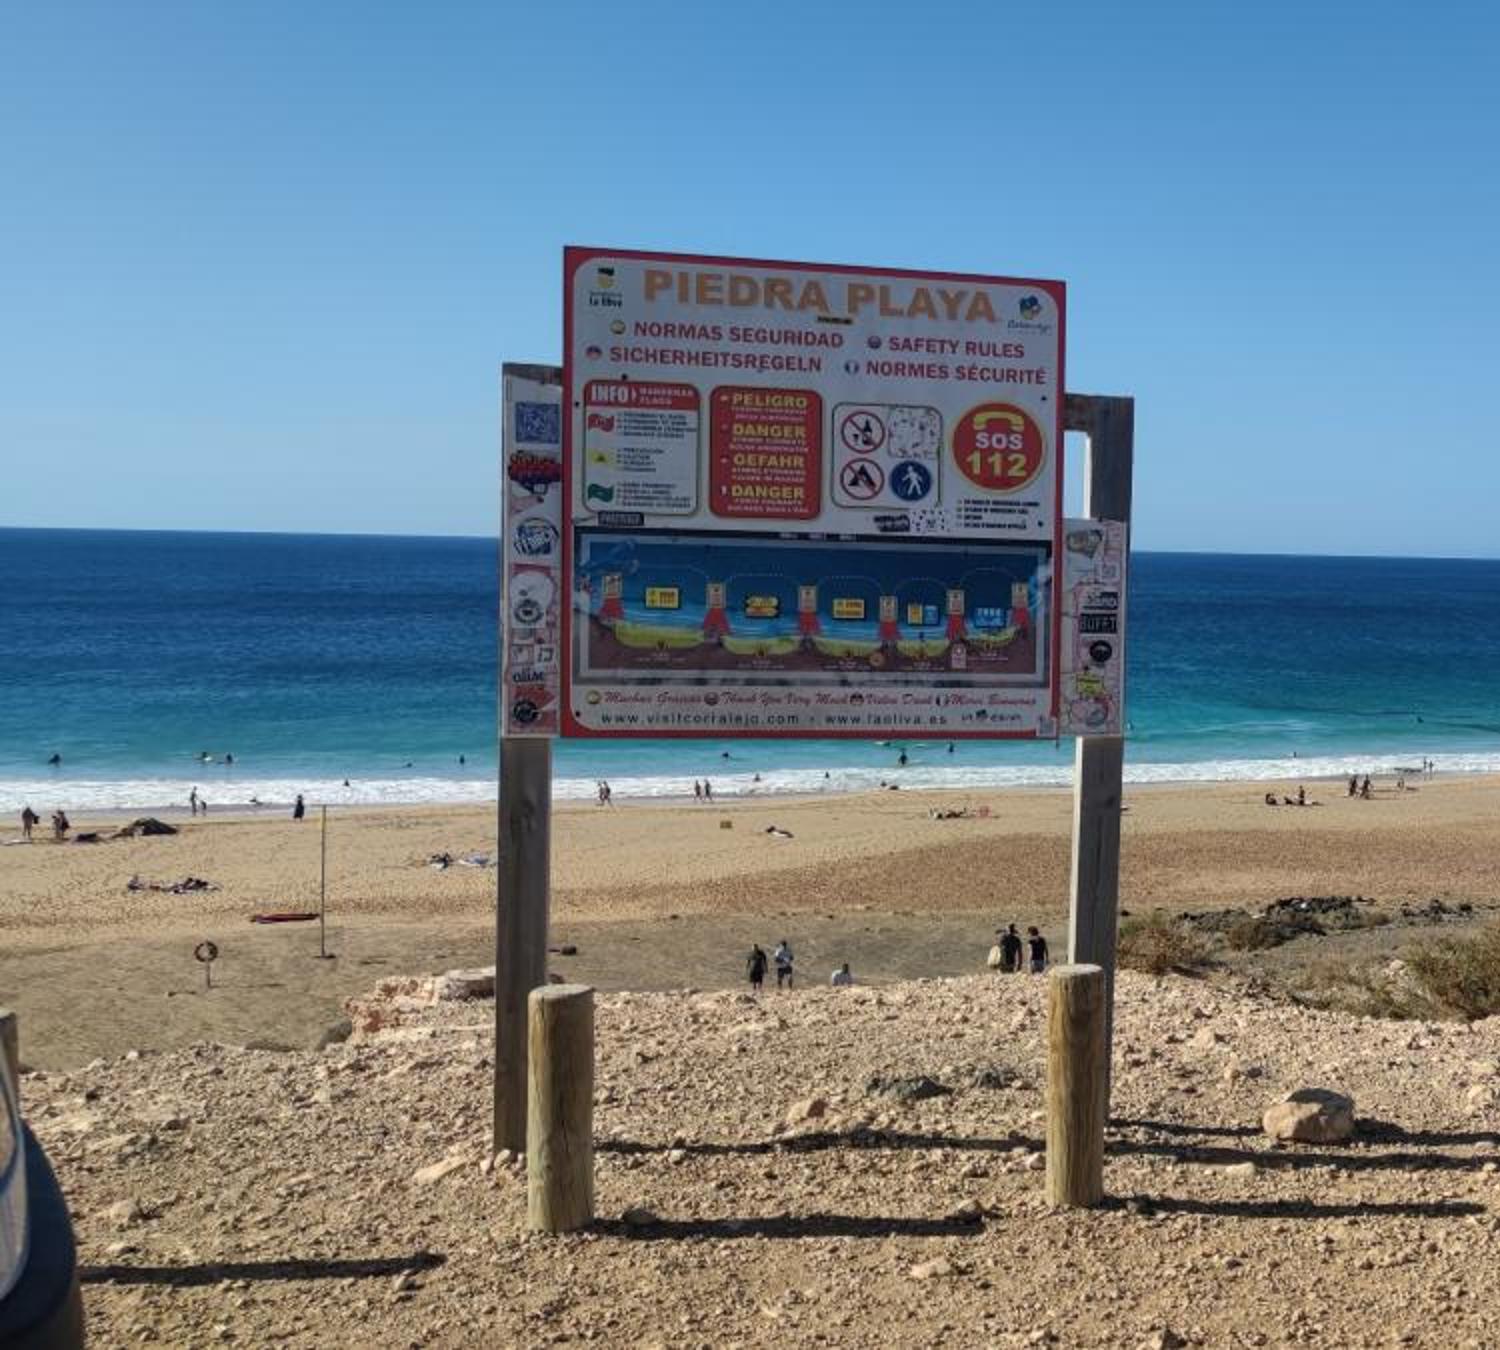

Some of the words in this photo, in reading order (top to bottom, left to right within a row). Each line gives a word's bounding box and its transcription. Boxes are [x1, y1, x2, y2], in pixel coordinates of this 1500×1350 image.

[644, 269, 830, 314] PIEDRA
[847, 282, 999, 323] PLAYA
[633, 321, 723, 342] NORMAS
[728, 326, 844, 348] SEGURIDAD
[889, 336, 959, 355] SAFETY
[965, 341, 1025, 359] RULES
[609, 346, 822, 373] SICHERHEITSREGELN
[866, 361, 949, 380] NORMES
[955, 362, 1047, 385] SÉCURITÉ
[591, 383, 629, 403] INFO
[733, 392, 808, 409] PELIGRO
[733, 423, 806, 439] DANGER
[975, 432, 1023, 450] SOS
[734, 453, 805, 468] GEFAHR
[965, 449, 1027, 477] 112
[731, 485, 805, 499] DANGER
[601, 711, 800, 727] www.visitcorralejo.com
[825, 712, 947, 725] www.laoliva.es
